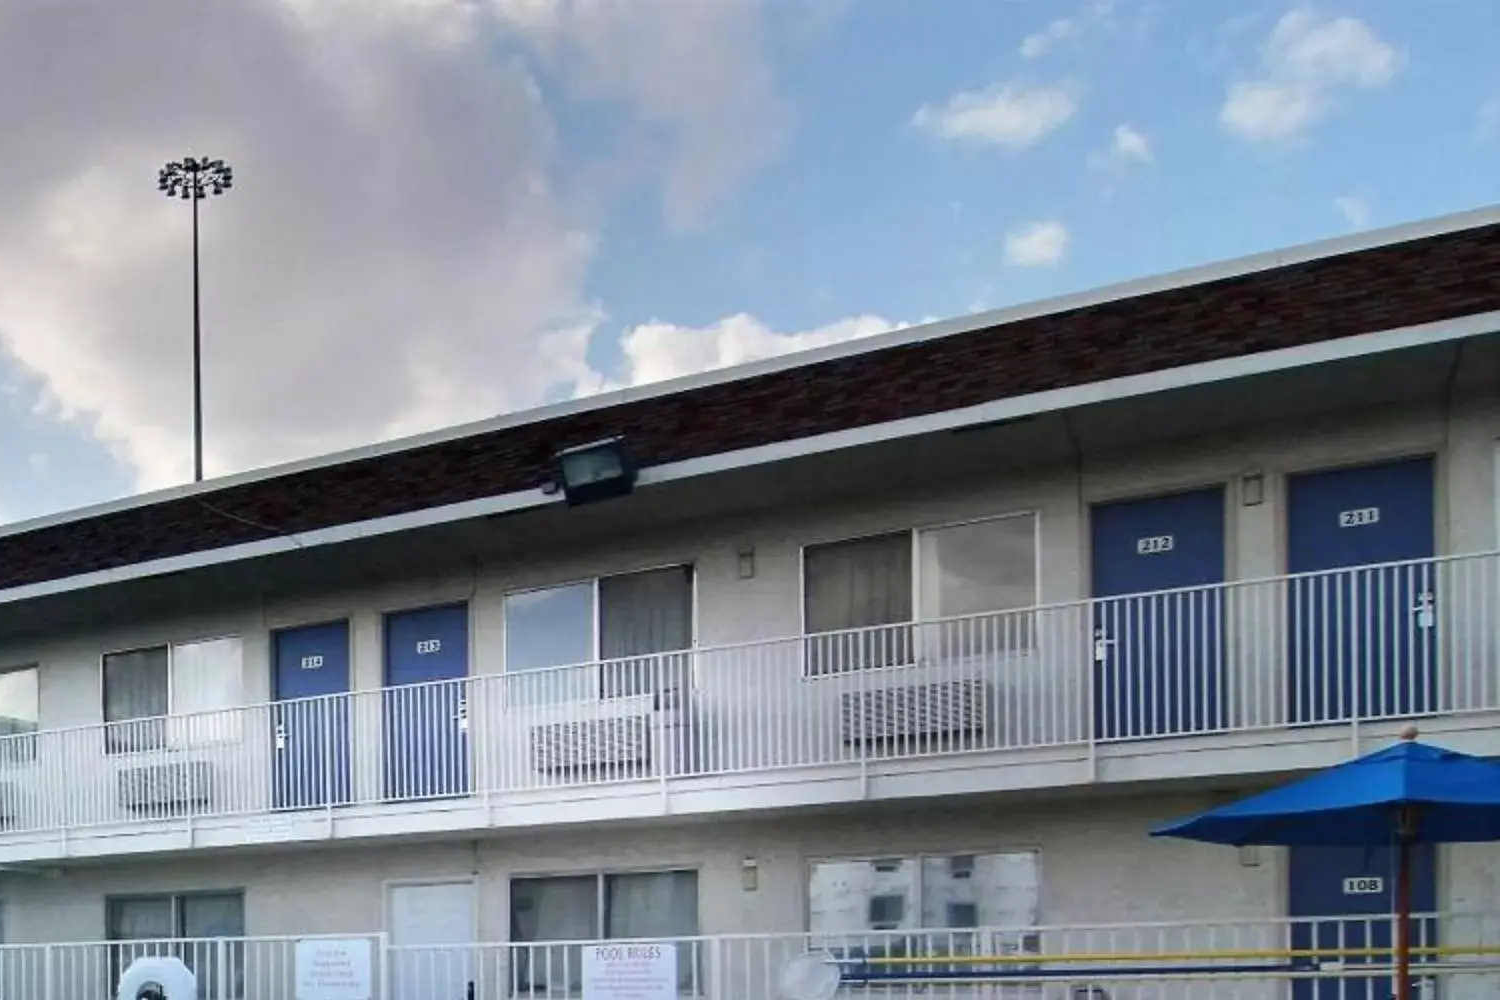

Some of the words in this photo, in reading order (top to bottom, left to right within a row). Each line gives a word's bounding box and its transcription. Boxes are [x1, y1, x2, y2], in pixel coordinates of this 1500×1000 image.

[1140, 536, 1171, 552] 212
[595, 947, 622, 960] POOL
[627, 946, 661, 960] RULES
